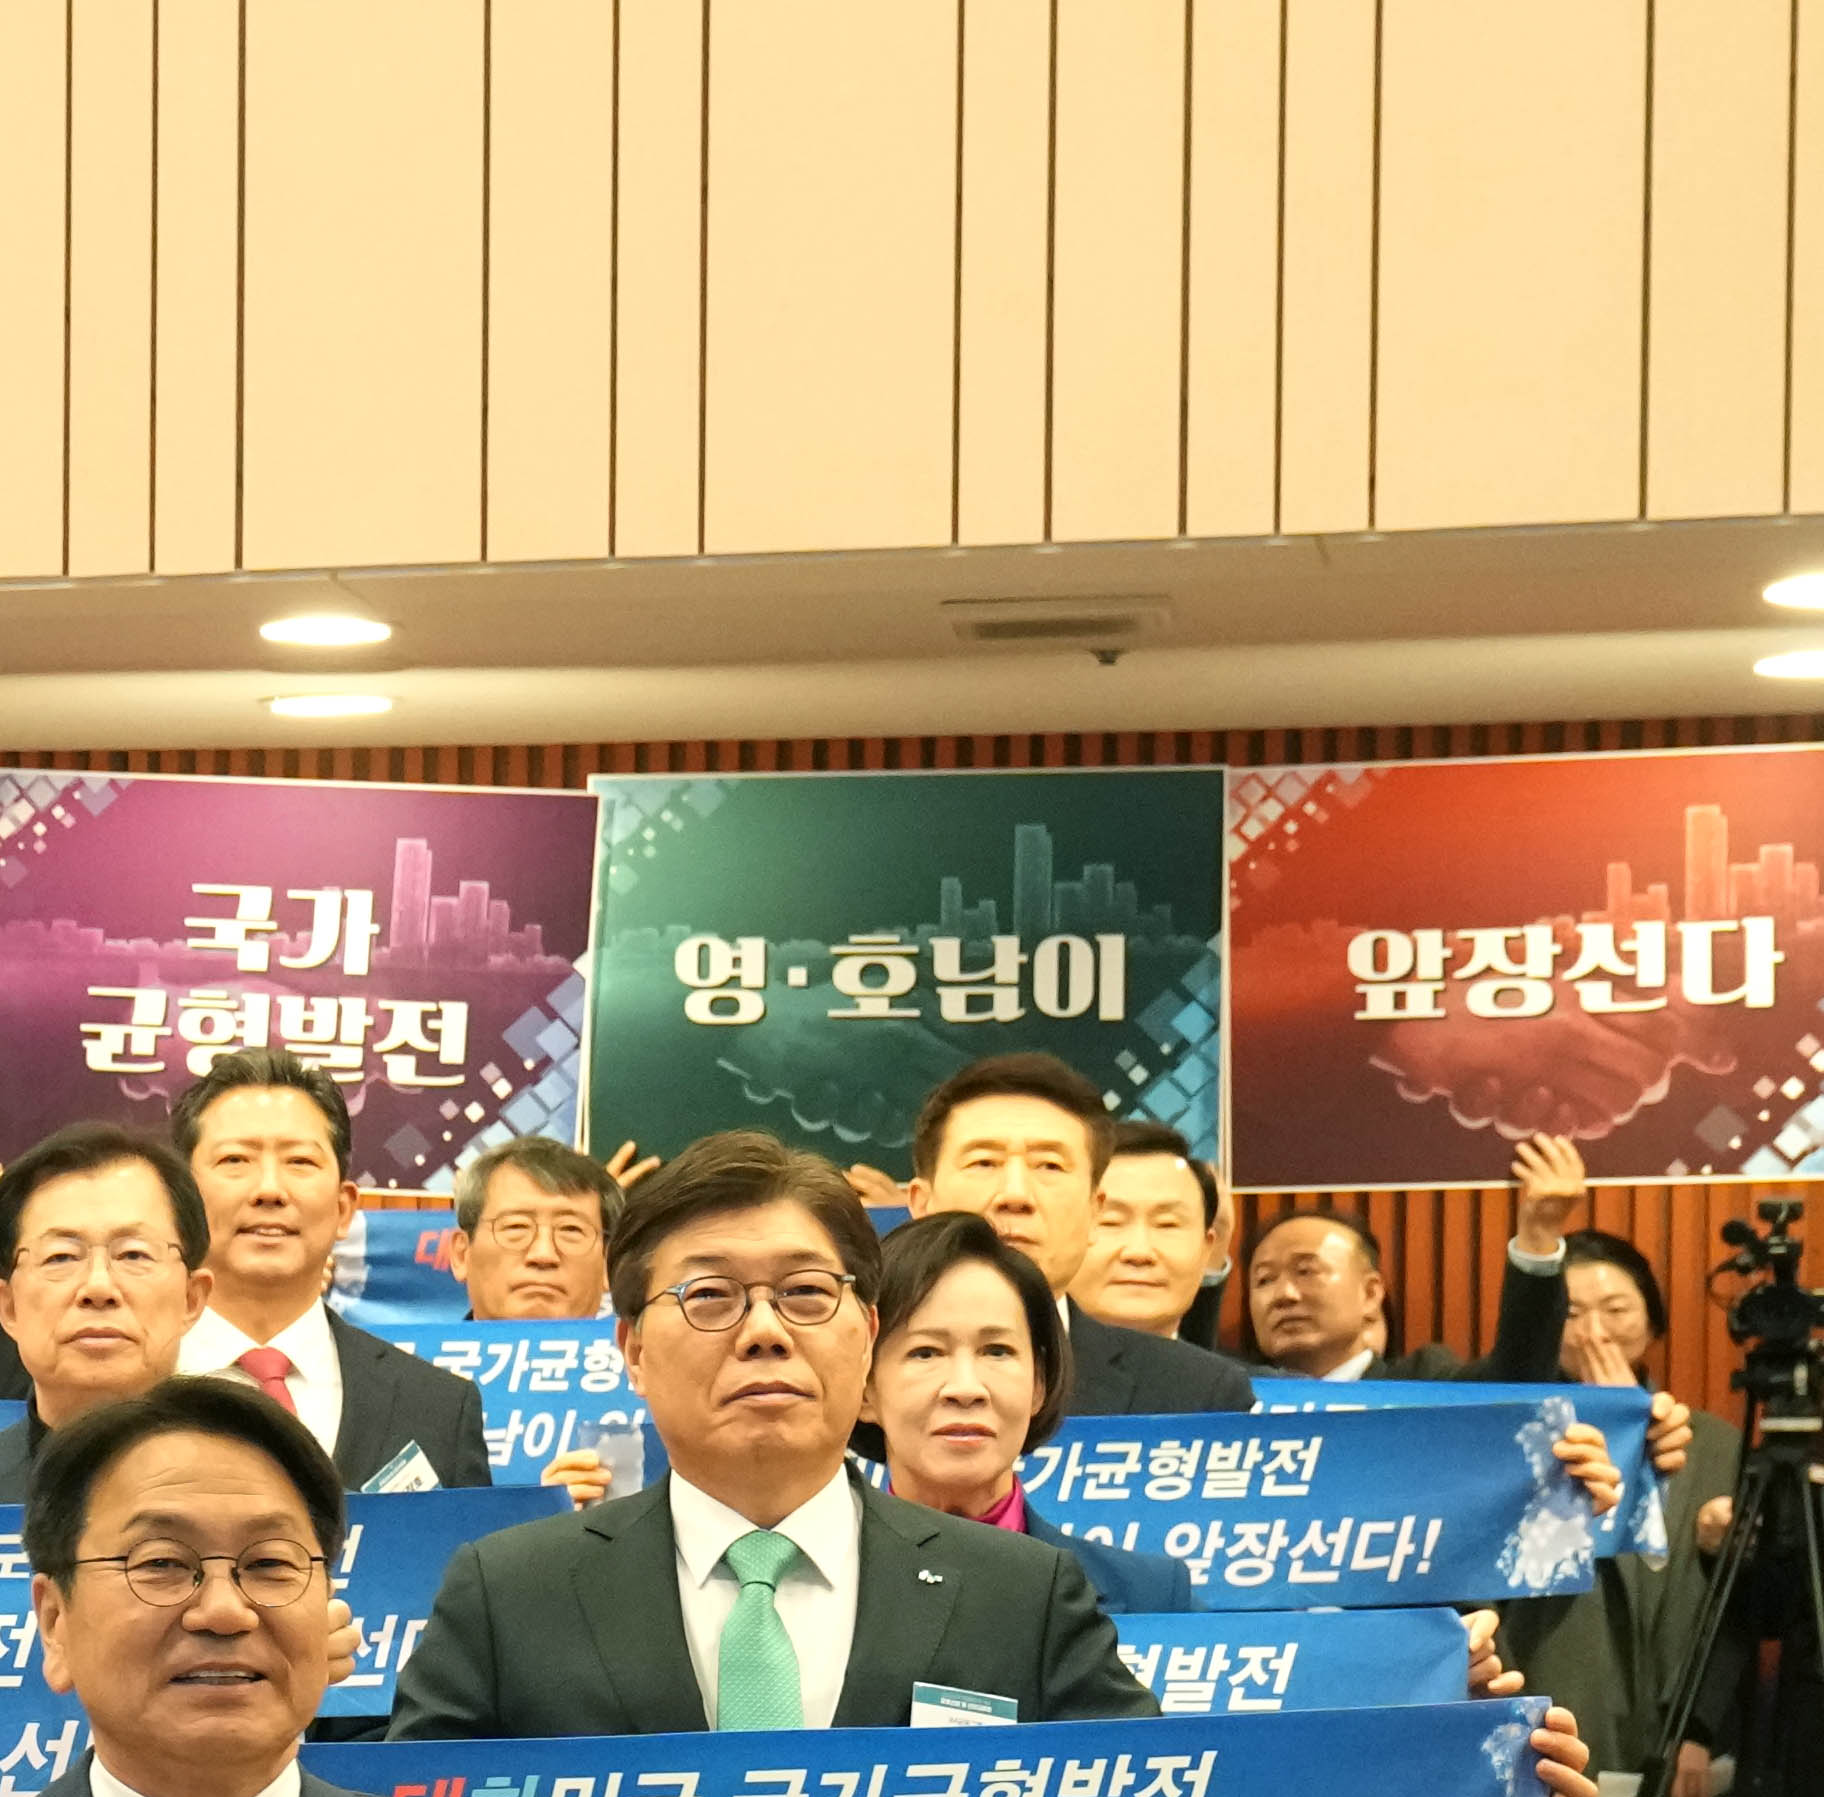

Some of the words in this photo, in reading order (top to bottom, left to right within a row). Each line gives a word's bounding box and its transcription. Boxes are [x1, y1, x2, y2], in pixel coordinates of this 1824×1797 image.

[184, 882, 381, 974] 국가
[1348, 916, 1785, 1020] 앞장선다
[80, 985, 469, 1088] 균형발전
